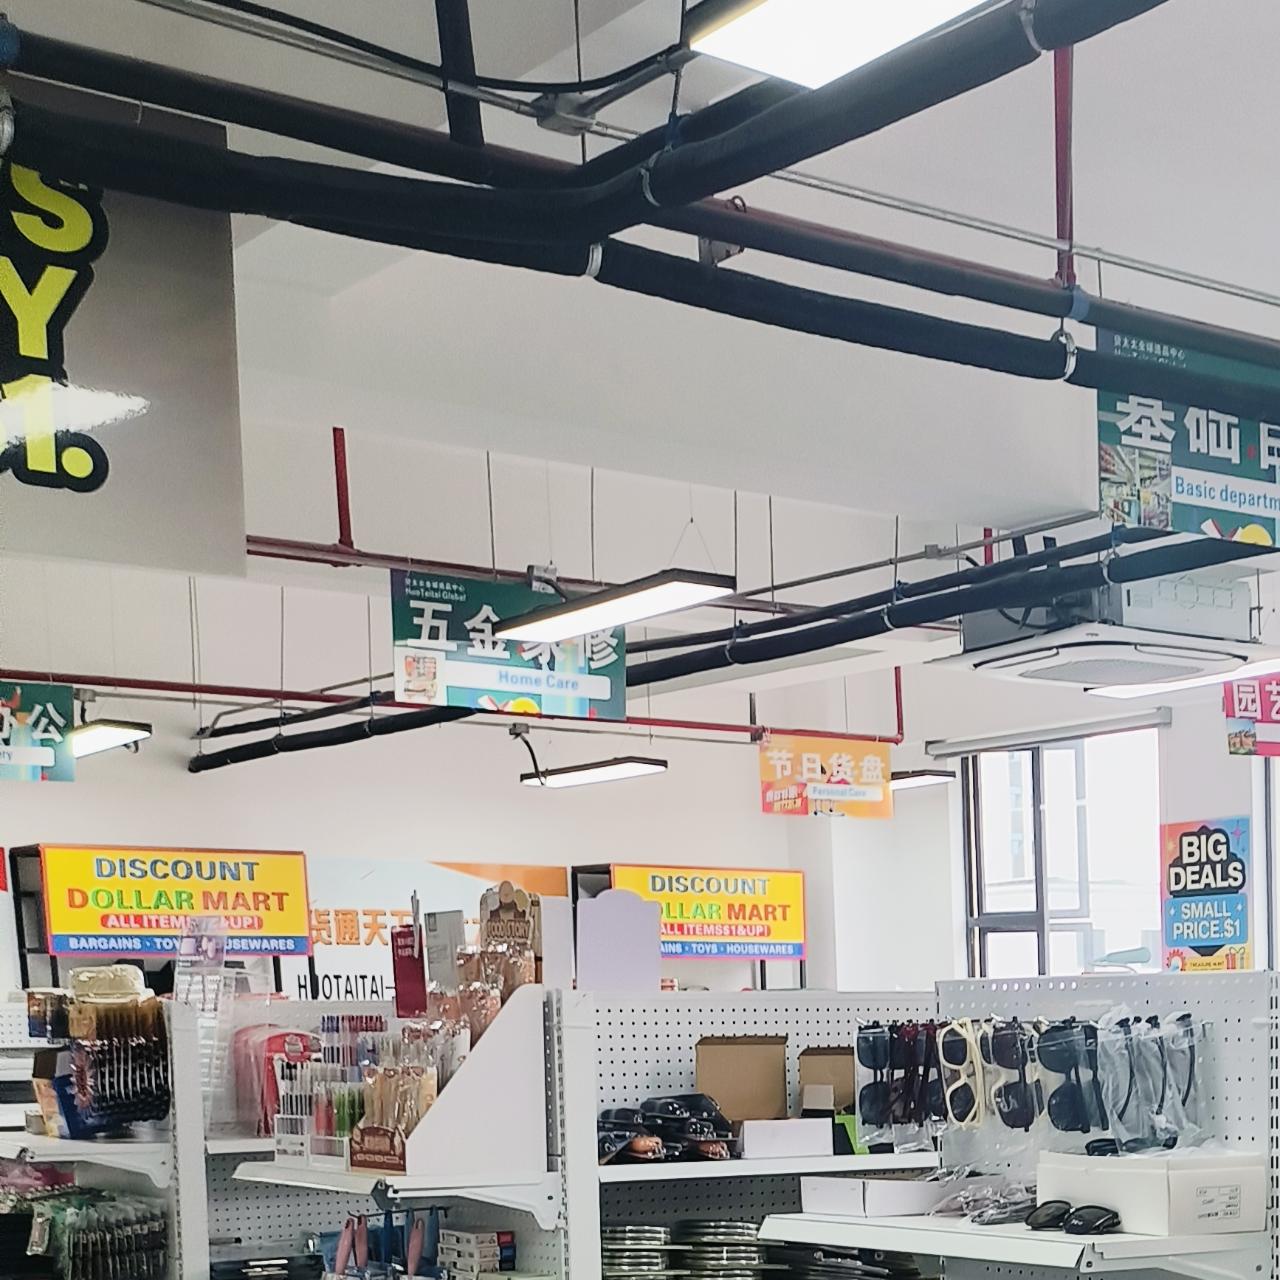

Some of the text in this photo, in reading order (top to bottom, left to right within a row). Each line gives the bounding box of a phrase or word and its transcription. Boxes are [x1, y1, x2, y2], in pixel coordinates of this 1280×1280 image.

[1175, 475, 1216, 501] Basic
[498, 669, 579, 692] Home Care
[1181, 832, 1228, 864] BIG
[95, 857, 260, 882] DISCOUNT
[1169, 861, 1244, 892] DEALS
[650, 875, 770, 896] DISCOUNT
[67, 887, 290, 912] DOLLAR MART
[1181, 901, 1232, 919] SMALL
[106, 914, 142, 929] ALL
[661, 902, 791, 922] LLAR MART
[69, 937, 295, 952] BARGAINS TOY USEWARES
[691, 942, 718, 955] TOYS
[726, 942, 794, 956] HOUSEWARES
